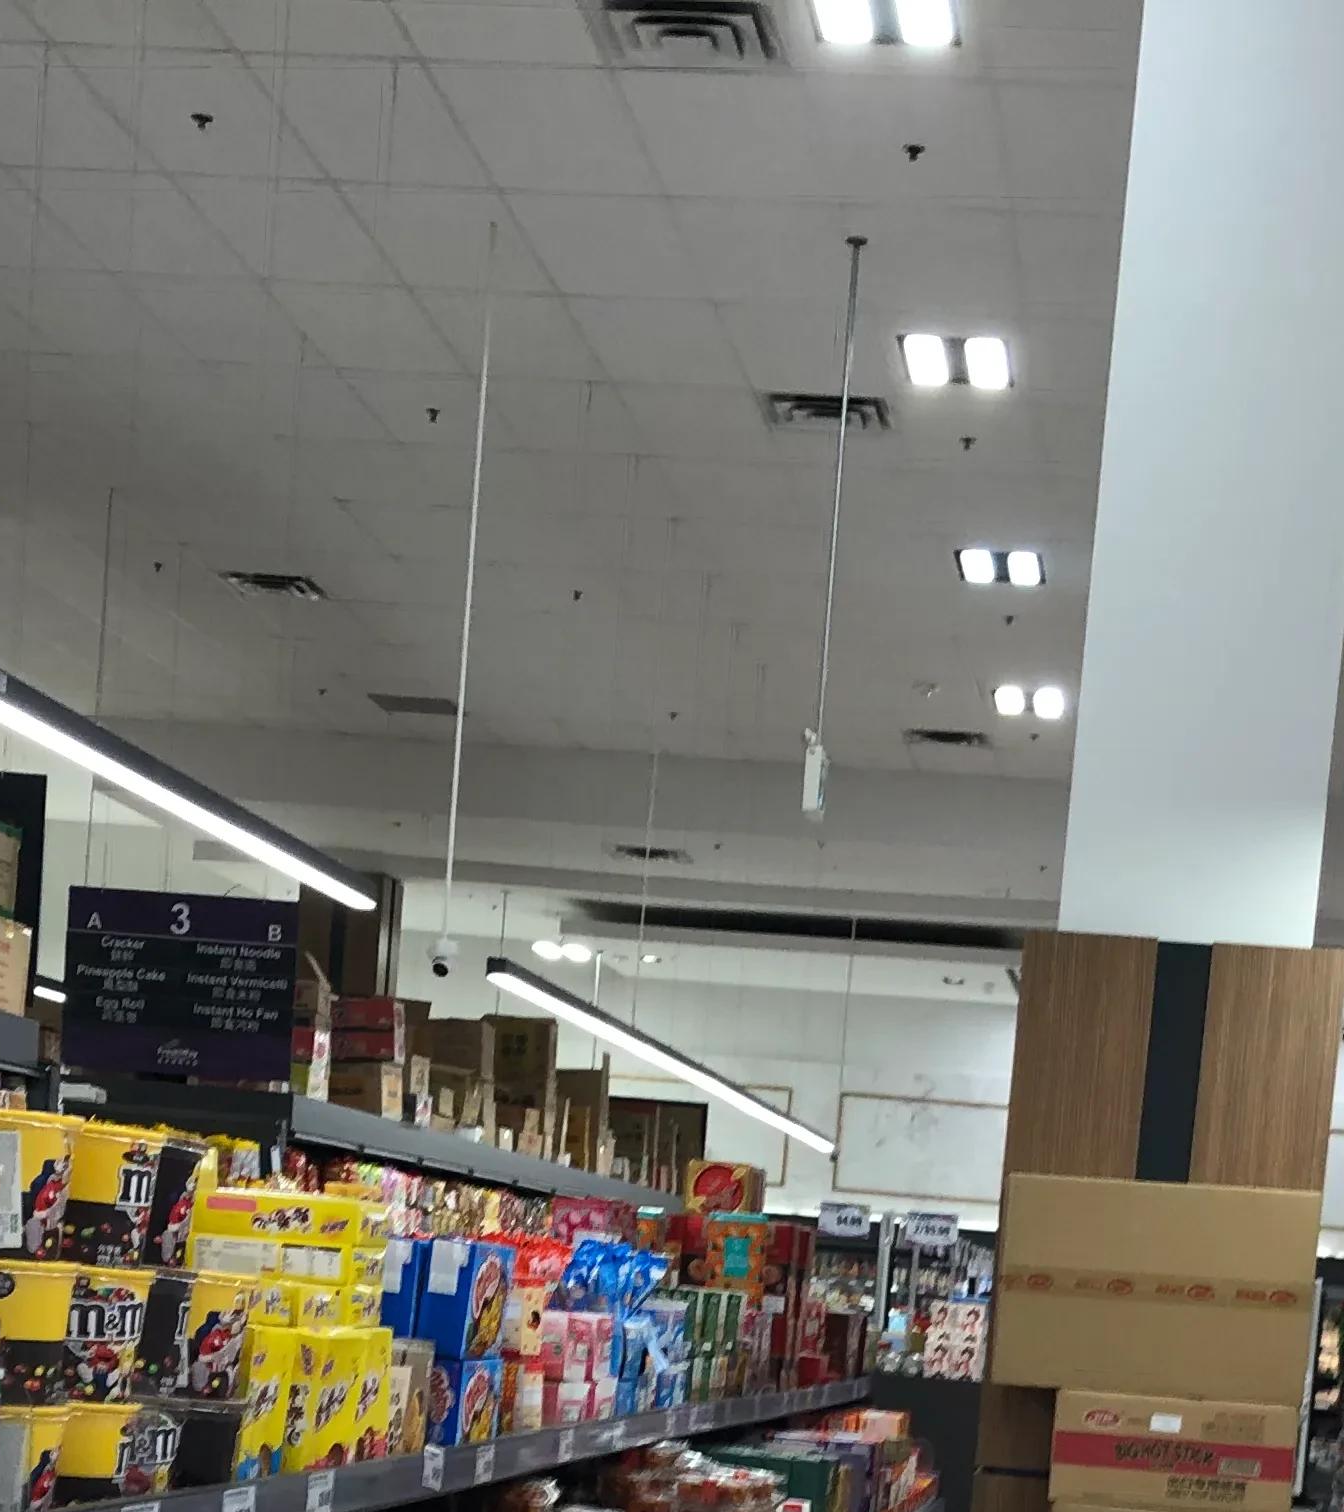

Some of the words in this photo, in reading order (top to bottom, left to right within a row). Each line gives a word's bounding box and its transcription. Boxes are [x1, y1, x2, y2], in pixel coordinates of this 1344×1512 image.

[87, 911, 103, 929] A
[169, 901, 192, 935] 3
[268, 924, 282, 941] B
